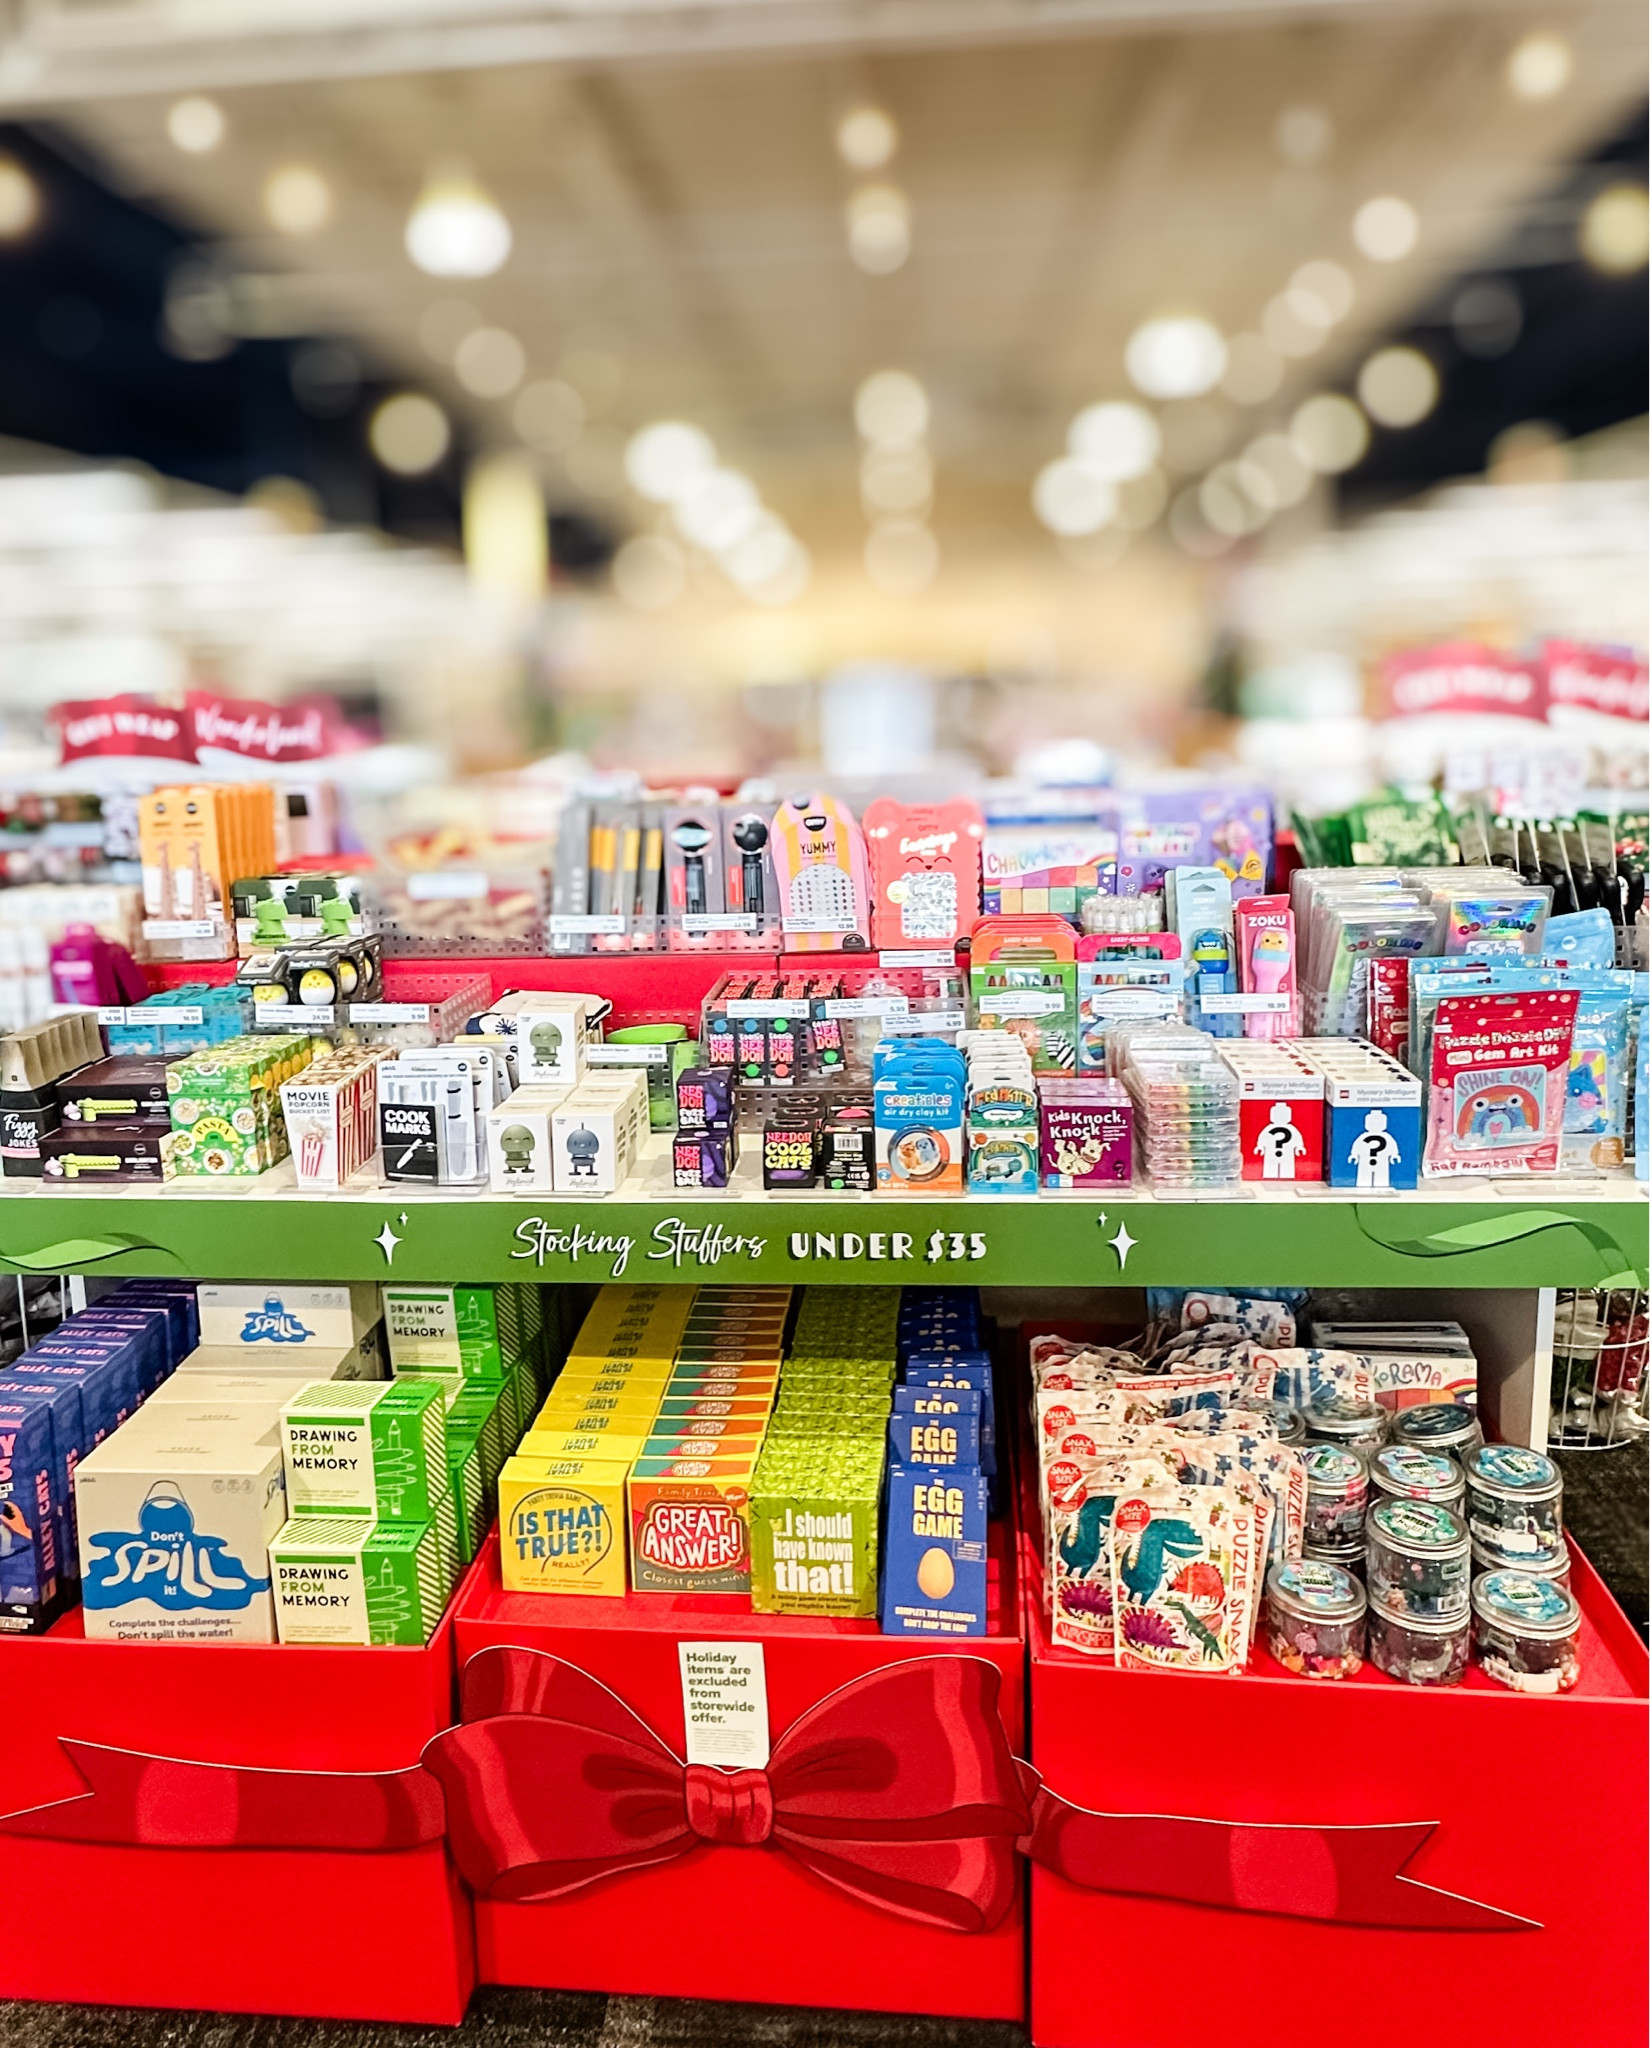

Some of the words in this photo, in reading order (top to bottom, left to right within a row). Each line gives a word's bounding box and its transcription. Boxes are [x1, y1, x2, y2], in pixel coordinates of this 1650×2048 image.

[800, 841, 836, 854] YUMMY
[1248, 915, 1287, 927] ZOKU
[816, 1036, 841, 1049] DOH
[711, 1051, 736, 1062] DOH
[741, 1051, 766, 1062] DOH
[771, 1049, 796, 1062] DOH
[1474, 1049, 1506, 1060] Gem
[1510, 1046, 1534, 1058] Art
[1538, 1044, 1559, 1056] Kit
[1457, 1071, 1502, 1097] SHINE
[1509, 1069, 1543, 1090] ON!
[287, 1092, 331, 1101] MOVIE
[679, 1085, 704, 1098] NEE
[1357, 1089, 1382, 1097] Mystery
[679, 1096, 704, 1108] DOH
[385, 1110, 430, 1124] COOK
[679, 1109, 705, 1118] FUZZ
[884, 1108, 897, 1116] air
[898, 1108, 914, 1117] dry
[916, 1108, 934, 1117] clay
[936, 1108, 949, 1116] kit
[1048, 1110, 1070, 1123] Kids
[1072, 1110, 1127, 1125] Knock,
[680, 1116, 705, 1125] BALL
[197, 1121, 231, 1136] PASTA
[385, 1123, 431, 1135] MARKS
[1050, 1123, 1100, 1138] Knock
[8, 1138, 38, 1148] JOKES
[766, 1132, 812, 1143] NEEDOH
[1269, 1127, 1292, 1157] ?
[675, 1146, 700, 1158] NEE
[765, 1143, 812, 1155] COOL
[1363, 1135, 1387, 1166] ?
[675, 1157, 700, 1169] DOH
[765, 1155, 812, 1169] CATS
[675, 1170, 701, 1178] FUZZ
[676, 1177, 701, 1186] BALL
[511, 1217, 635, 1277] Stocking
[646, 1217, 767, 1268] Stuffers
[791, 1232, 914, 1260] UNDER
[926, 1229, 988, 1264] $35
[390, 1304, 444, 1315] DRAWING
[392, 1316, 426, 1326] FROM
[394, 1327, 446, 1337] MEMORY
[37, 1346, 74, 1354] ALLEY
[14, 1364, 52, 1372] ALLEY
[291, 1430, 358, 1442] DRAWING
[911, 1426, 957, 1453] EGG
[292, 1444, 334, 1455] FROM
[293, 1458, 358, 1470] MEMORY
[1056, 1475, 1074, 1484] SIZE
[35, 1469, 51, 1516] CATS
[565, 1493, 582, 1503] GAME
[657, 1487, 691, 1499] Family
[914, 1485, 964, 1515] EGG
[518, 1511, 539, 1535] IS
[544, 1505, 604, 1531] THAT
[1123, 1512, 1142, 1520] SIZE
[655, 1508, 727, 1540] GREAT
[796, 1511, 852, 1539] should
[913, 1514, 963, 1539] GAME
[150, 1531, 184, 1541] Don't
[40, 1524, 55, 1571] ALLEY
[516, 1529, 603, 1560] TRUE?!
[646, 1521, 739, 1566] ANSWER!
[774, 1538, 806, 1559] have
[808, 1538, 853, 1562] known
[1232, 1516, 1249, 1591] PUZZLE
[280, 1568, 349, 1579] DRAWING
[774, 1560, 854, 1594] that!
[643, 1570, 684, 1586] Closest
[687, 1576, 718, 1590] guess
[164, 1585, 177, 1596] it!
[281, 1582, 325, 1593] FROM
[282, 1595, 350, 1606] MEMORY
[895, 1606, 926, 1617] COMPLETE
[927, 1608, 938, 1618] THE
[109, 1619, 156, 1628] Complete
[158, 1618, 175, 1626] the
[904, 1618, 921, 1628] DON'T
[923, 1619, 940, 1629] DROP
[940, 1621, 951, 1630] THE
[1229, 1599, 1245, 1657] SNAX
[118, 1631, 148, 1640] Don't
[151, 1631, 174, 1640] spill
[177, 1630, 195, 1638] the
[198, 1629, 232, 1638] water!
[686, 1652, 737, 1665] Holiday
[687, 1664, 724, 1674] items
[730, 1667, 752, 1675] are
[688, 1676, 747, 1687] excluded
[689, 1688, 721, 1698] from
[690, 1700, 755, 1712] storewide
[691, 1713, 726, 1724] offer.
